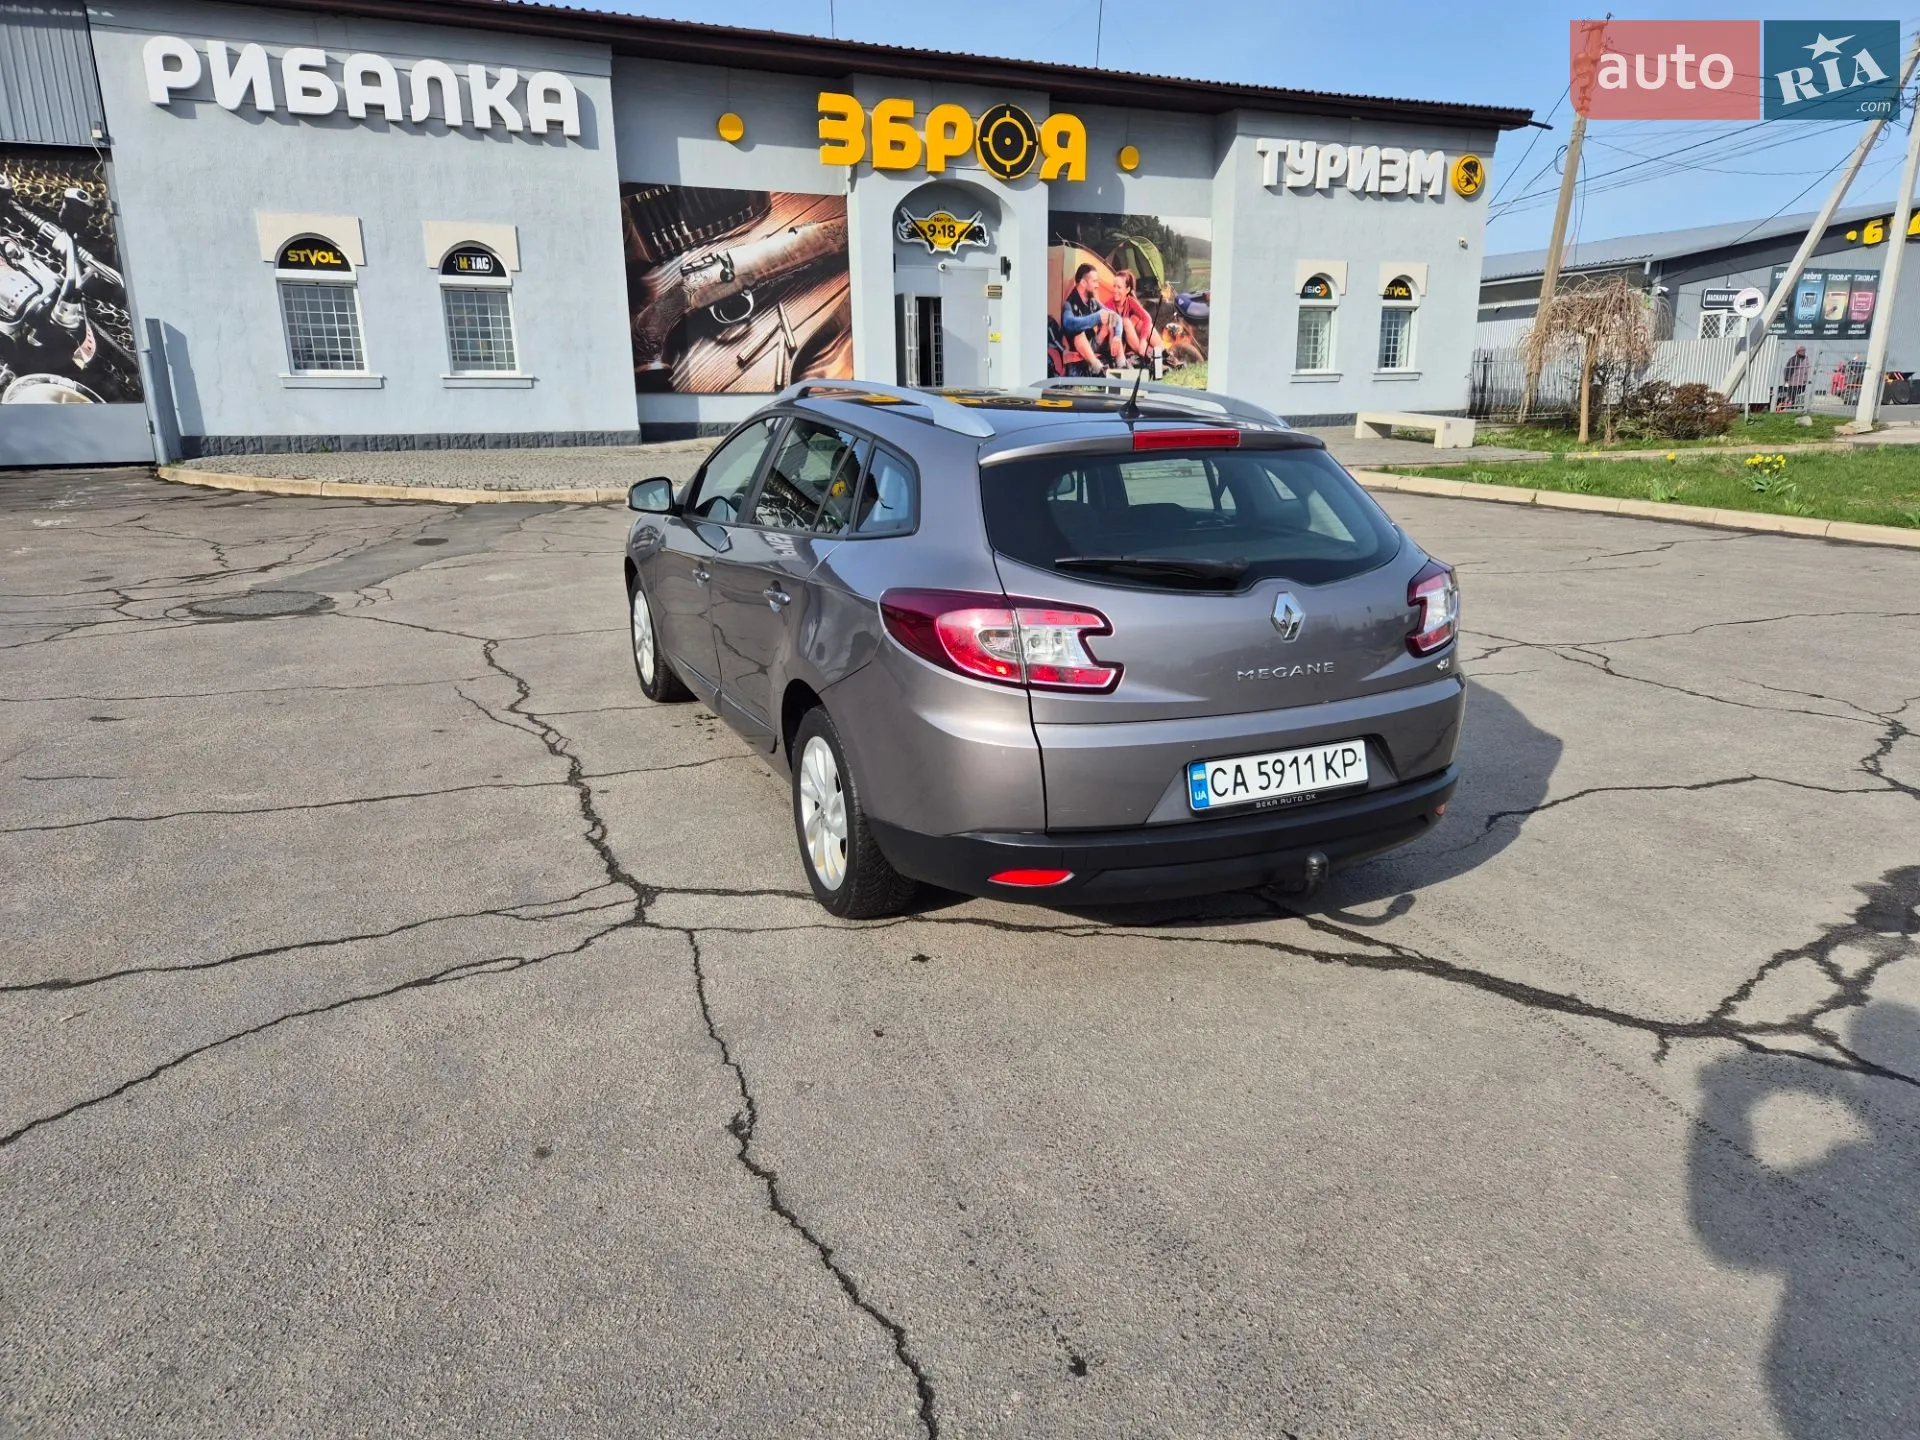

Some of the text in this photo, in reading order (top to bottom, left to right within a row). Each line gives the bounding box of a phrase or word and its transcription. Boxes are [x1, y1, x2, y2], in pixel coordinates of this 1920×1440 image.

[143, 36, 581, 137] РИБАЛКА
[818, 92, 1087, 182] ЗБРОЯ
[1257, 138, 1445, 196] ТУРИЗМ
[287, 248, 342, 266] STVOL
[1236, 661, 1335, 681] MEGANE
[1194, 790, 1207, 801] UA
[1210, 747, 1357, 797] CA 5911 KP
